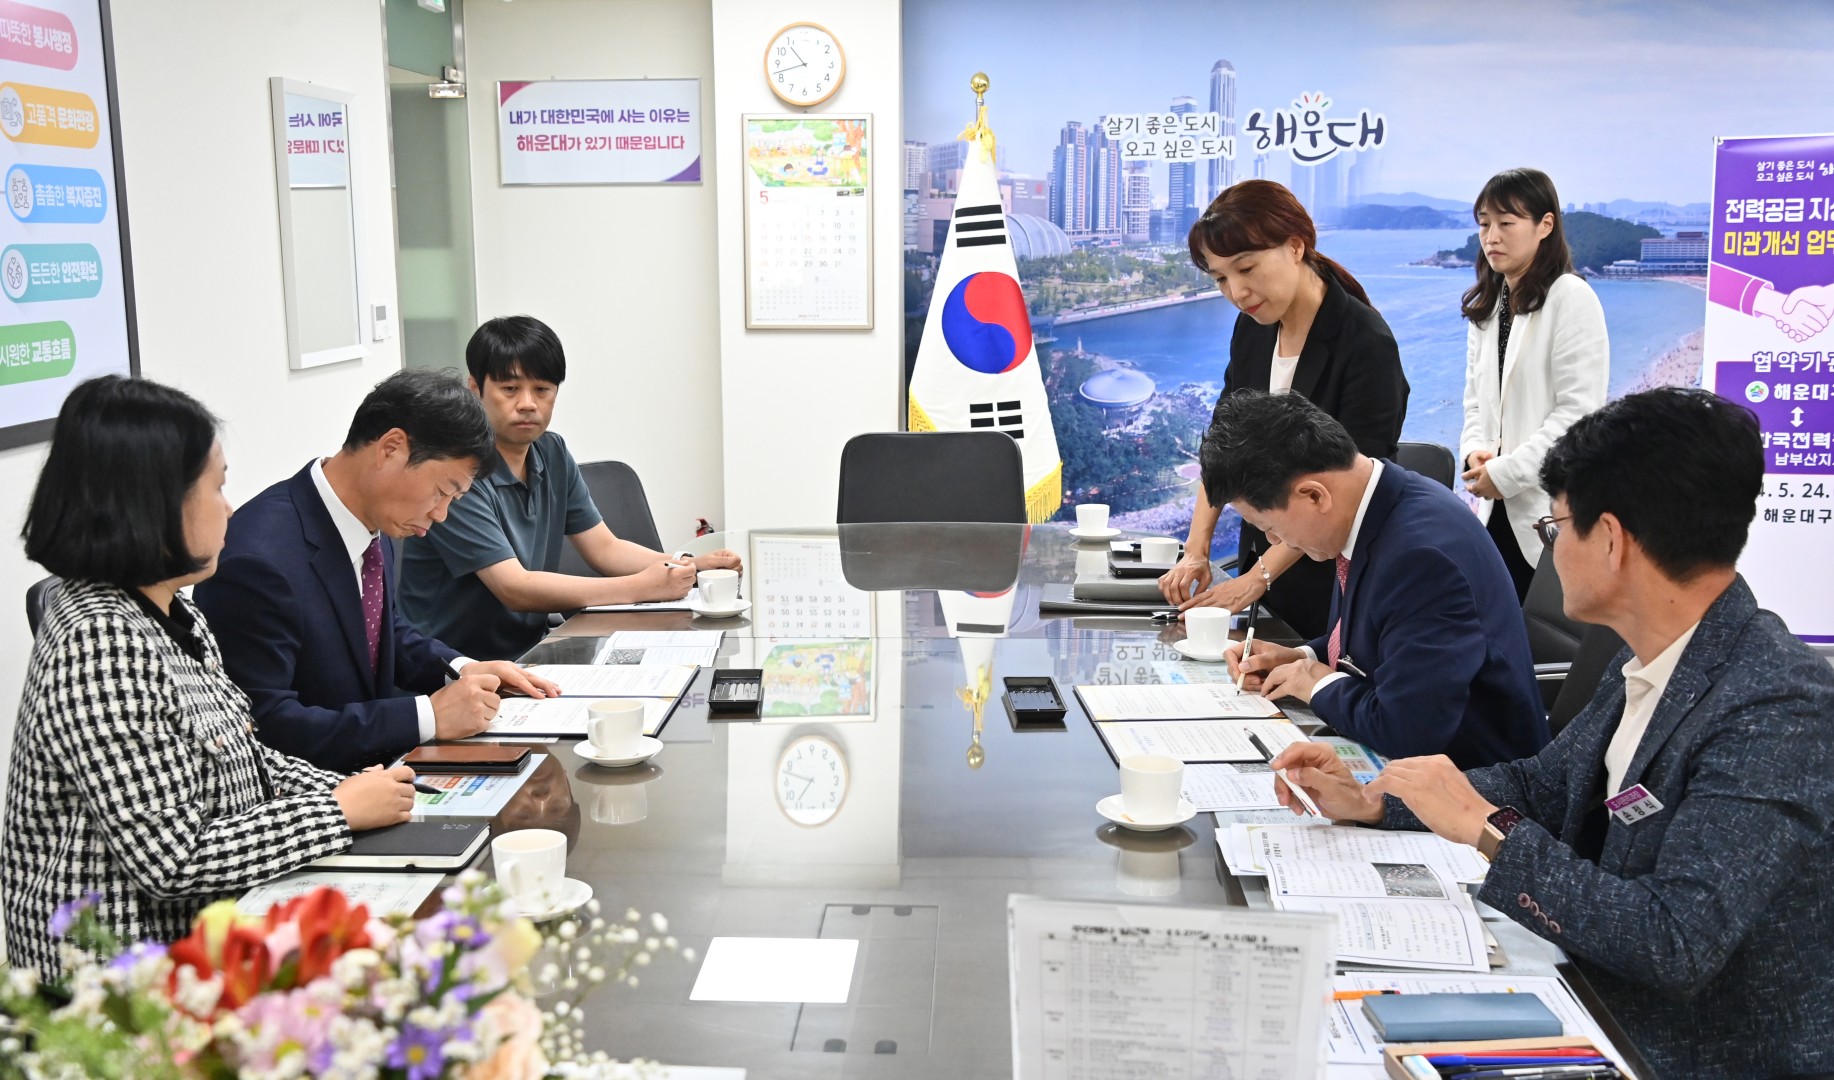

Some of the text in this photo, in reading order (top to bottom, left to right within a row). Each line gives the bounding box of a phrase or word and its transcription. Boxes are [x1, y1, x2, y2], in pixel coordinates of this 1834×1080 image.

[33, 25, 73, 54] 봉사행정
[776, 46, 787, 56] 10
[26, 103, 94, 132] 고품격 문화관광
[509, 108, 690, 125] 내가 대한민국에 사는 이유는
[1106, 115, 1216, 136] 살기 좋은 도시
[516, 134, 685, 151] 해운대가 있기 때문입니다
[1124, 138, 1232, 159] 오고 싶은 도시
[1756, 159, 1815, 172] 살기 좋은 도시
[1756, 171, 1814, 183] 오고 싶은 도시
[35, 184, 102, 208] 촘촘한 복지증진
[759, 190, 769, 205] 5
[1725, 197, 1834, 223] 전력공급 지
[1724, 230, 1800, 256] 미관개선
[30, 261, 99, 285] 든든한 안전확보
[0, 337, 71, 367] 시원한 교통흐름
[1774, 383, 1834, 400] 해운대
[1760, 431, 1834, 449] 국전력
[1775, 452, 1834, 466] 남부산지
[1778, 482, 1794, 498] 5.
[1802, 482, 1830, 498] 24.
[1764, 508, 1832, 524] 해운대구
